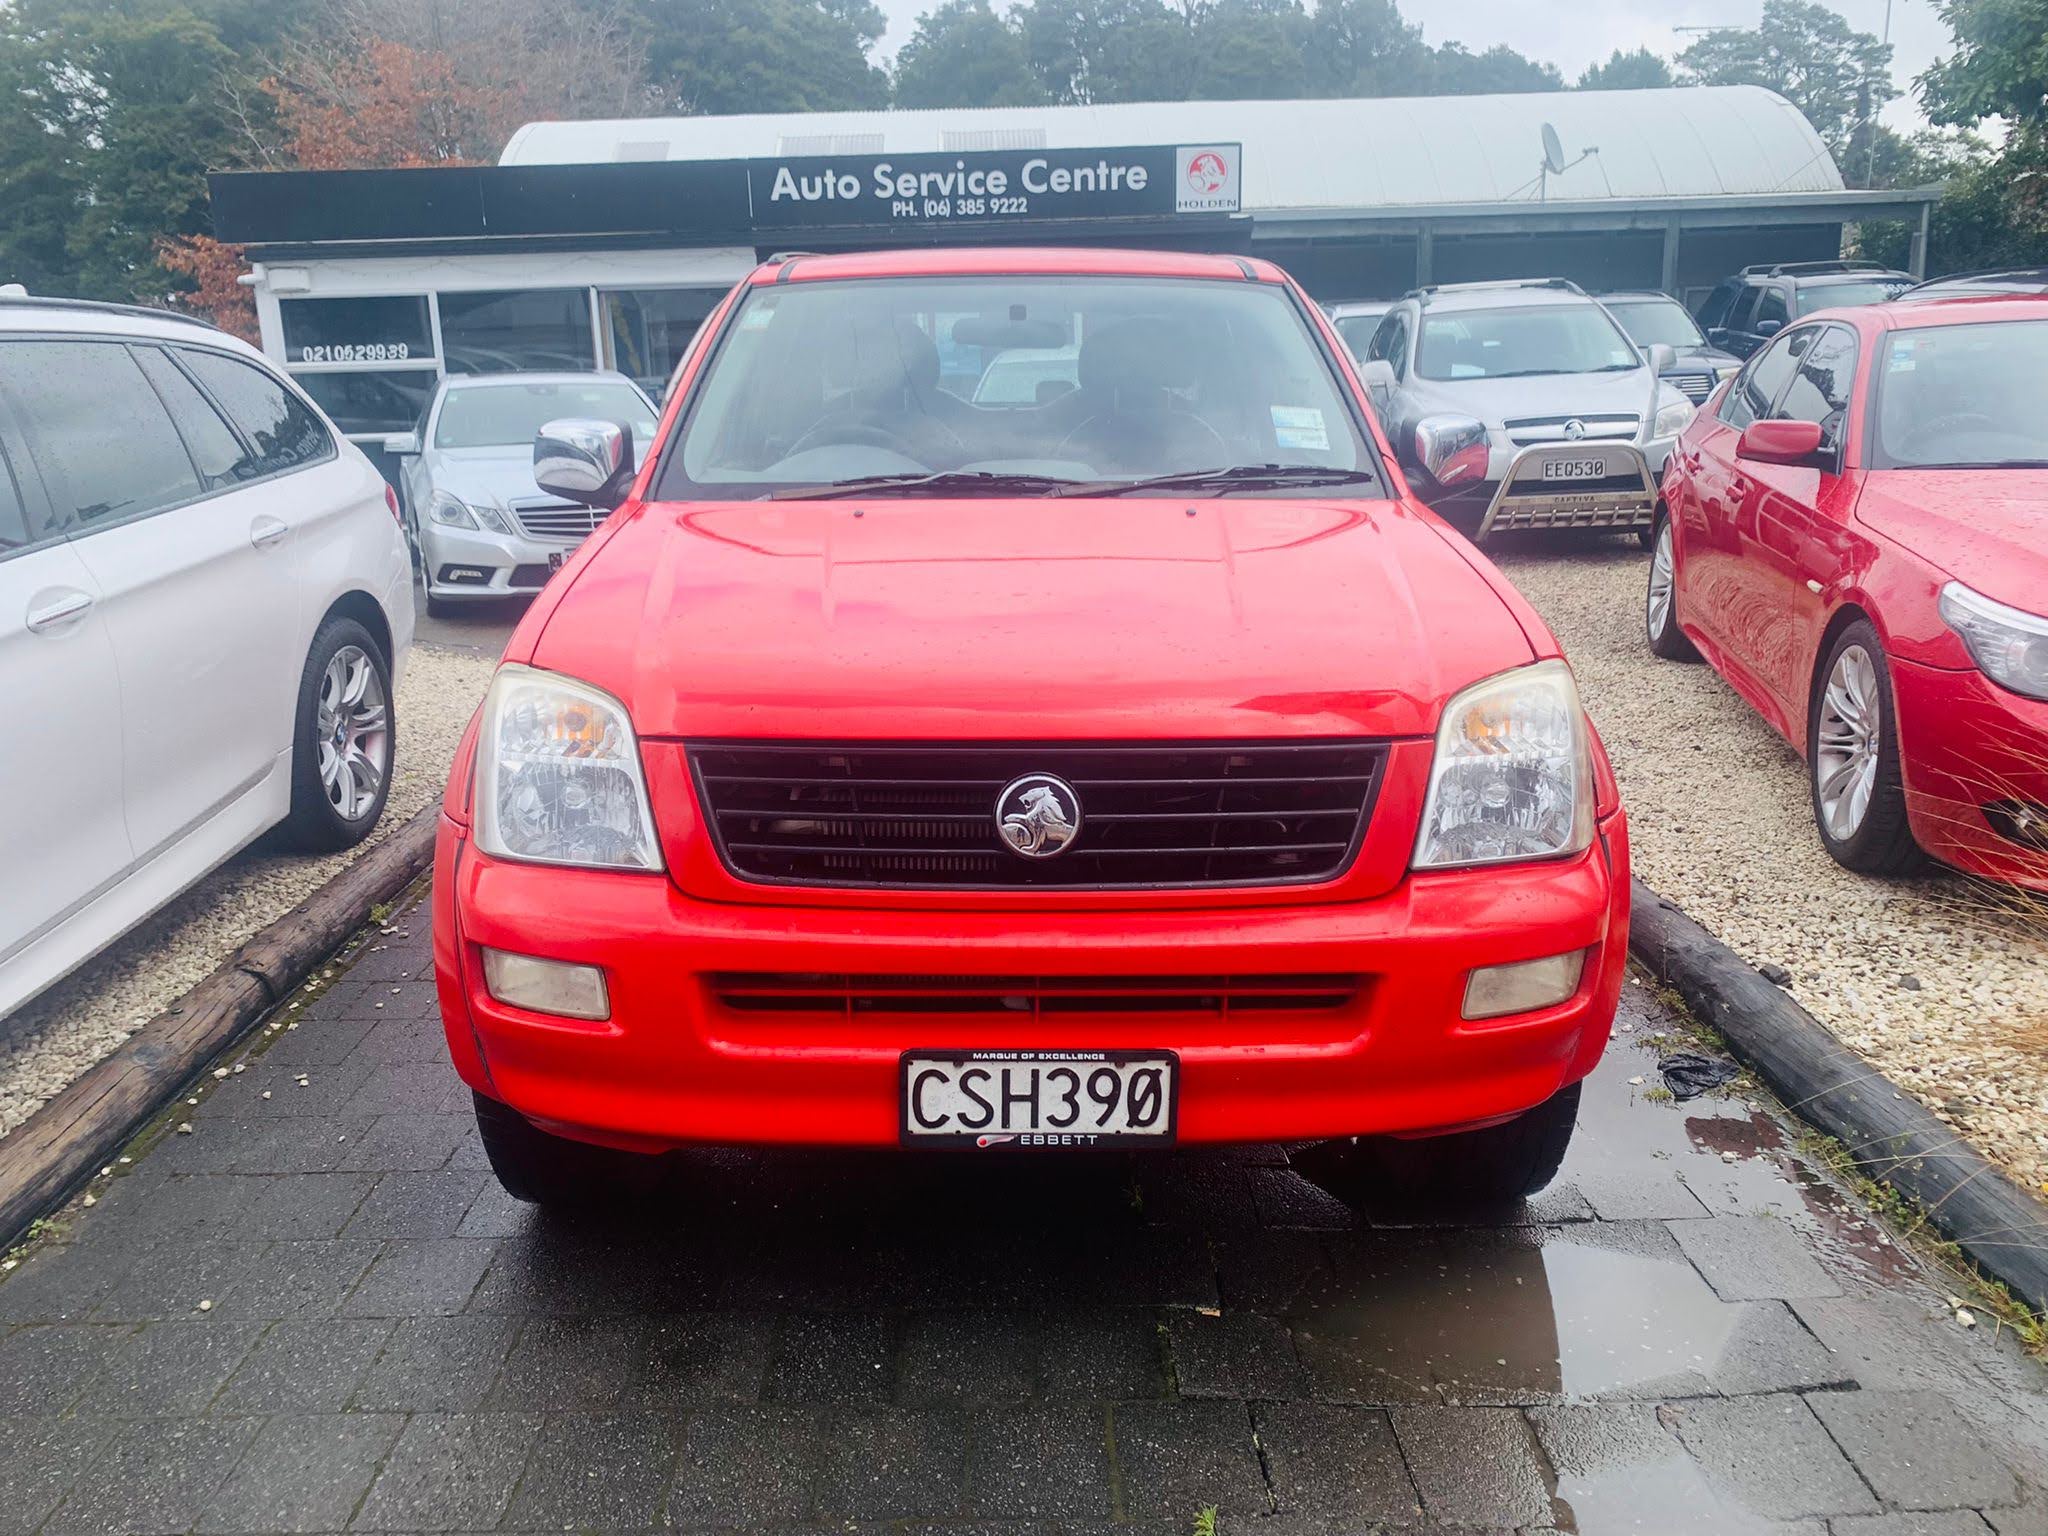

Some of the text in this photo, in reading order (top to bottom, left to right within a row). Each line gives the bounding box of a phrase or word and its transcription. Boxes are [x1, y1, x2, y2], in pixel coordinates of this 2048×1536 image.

[771, 159, 1148, 200] Auto Service Centre
[892, 197, 1028, 217] PH. (06) 385 9222
[1178, 200, 1237, 209] HOLDEN
[1545, 460, 1604, 478] EEQ530
[973, 1052, 1106, 1060] MARQUE OF EXCELLENCE
[912, 1068, 1163, 1129] CSH390
[1021, 1135, 1098, 1146] EBBETT
